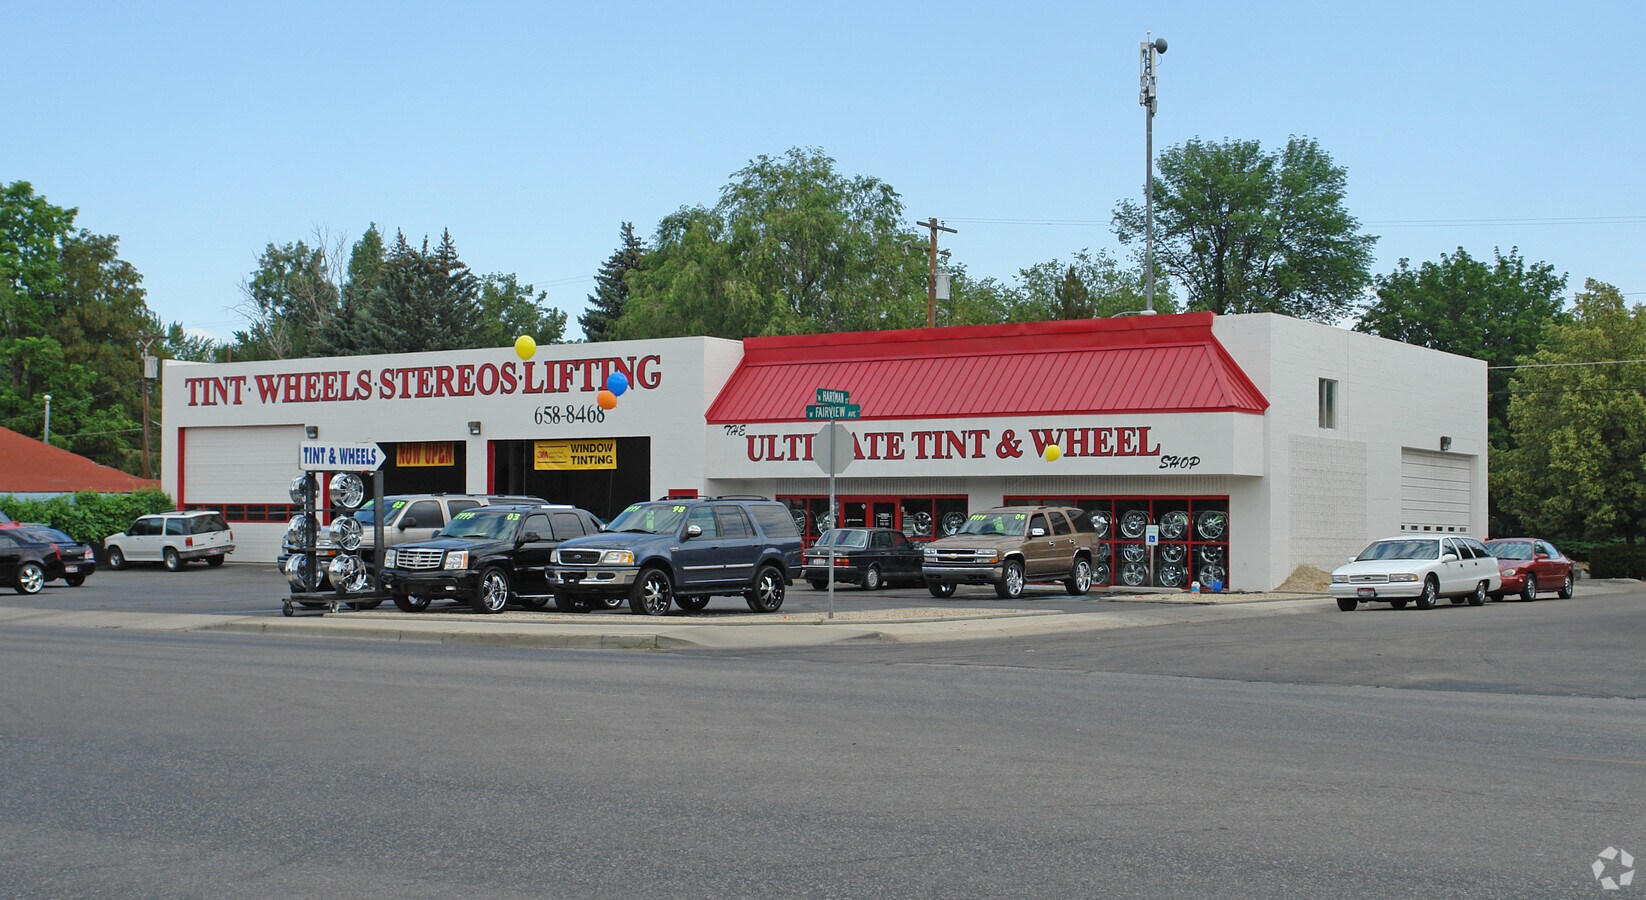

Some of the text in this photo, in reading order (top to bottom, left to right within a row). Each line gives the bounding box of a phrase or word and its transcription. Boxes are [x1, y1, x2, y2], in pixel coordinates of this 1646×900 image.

[185, 355, 662, 406] TINT WHEELS STEREOS LIFTING
[534, 404, 605, 425] 658-8468
[815, 406, 846, 418] FAIRVIEW
[723, 424, 747, 436] THE
[570, 443, 613, 453] WINDOW
[745, 426, 1161, 462] ULTIATE TINT & WHEEL
[303, 447, 376, 465] TINT & WHEELS
[425, 443, 453, 464] OPEN
[570, 455, 613, 465] TINTING
[1159, 455, 1201, 470] SHOP
[672, 505, 686, 513] 98
[507, 513, 520, 521] 03
